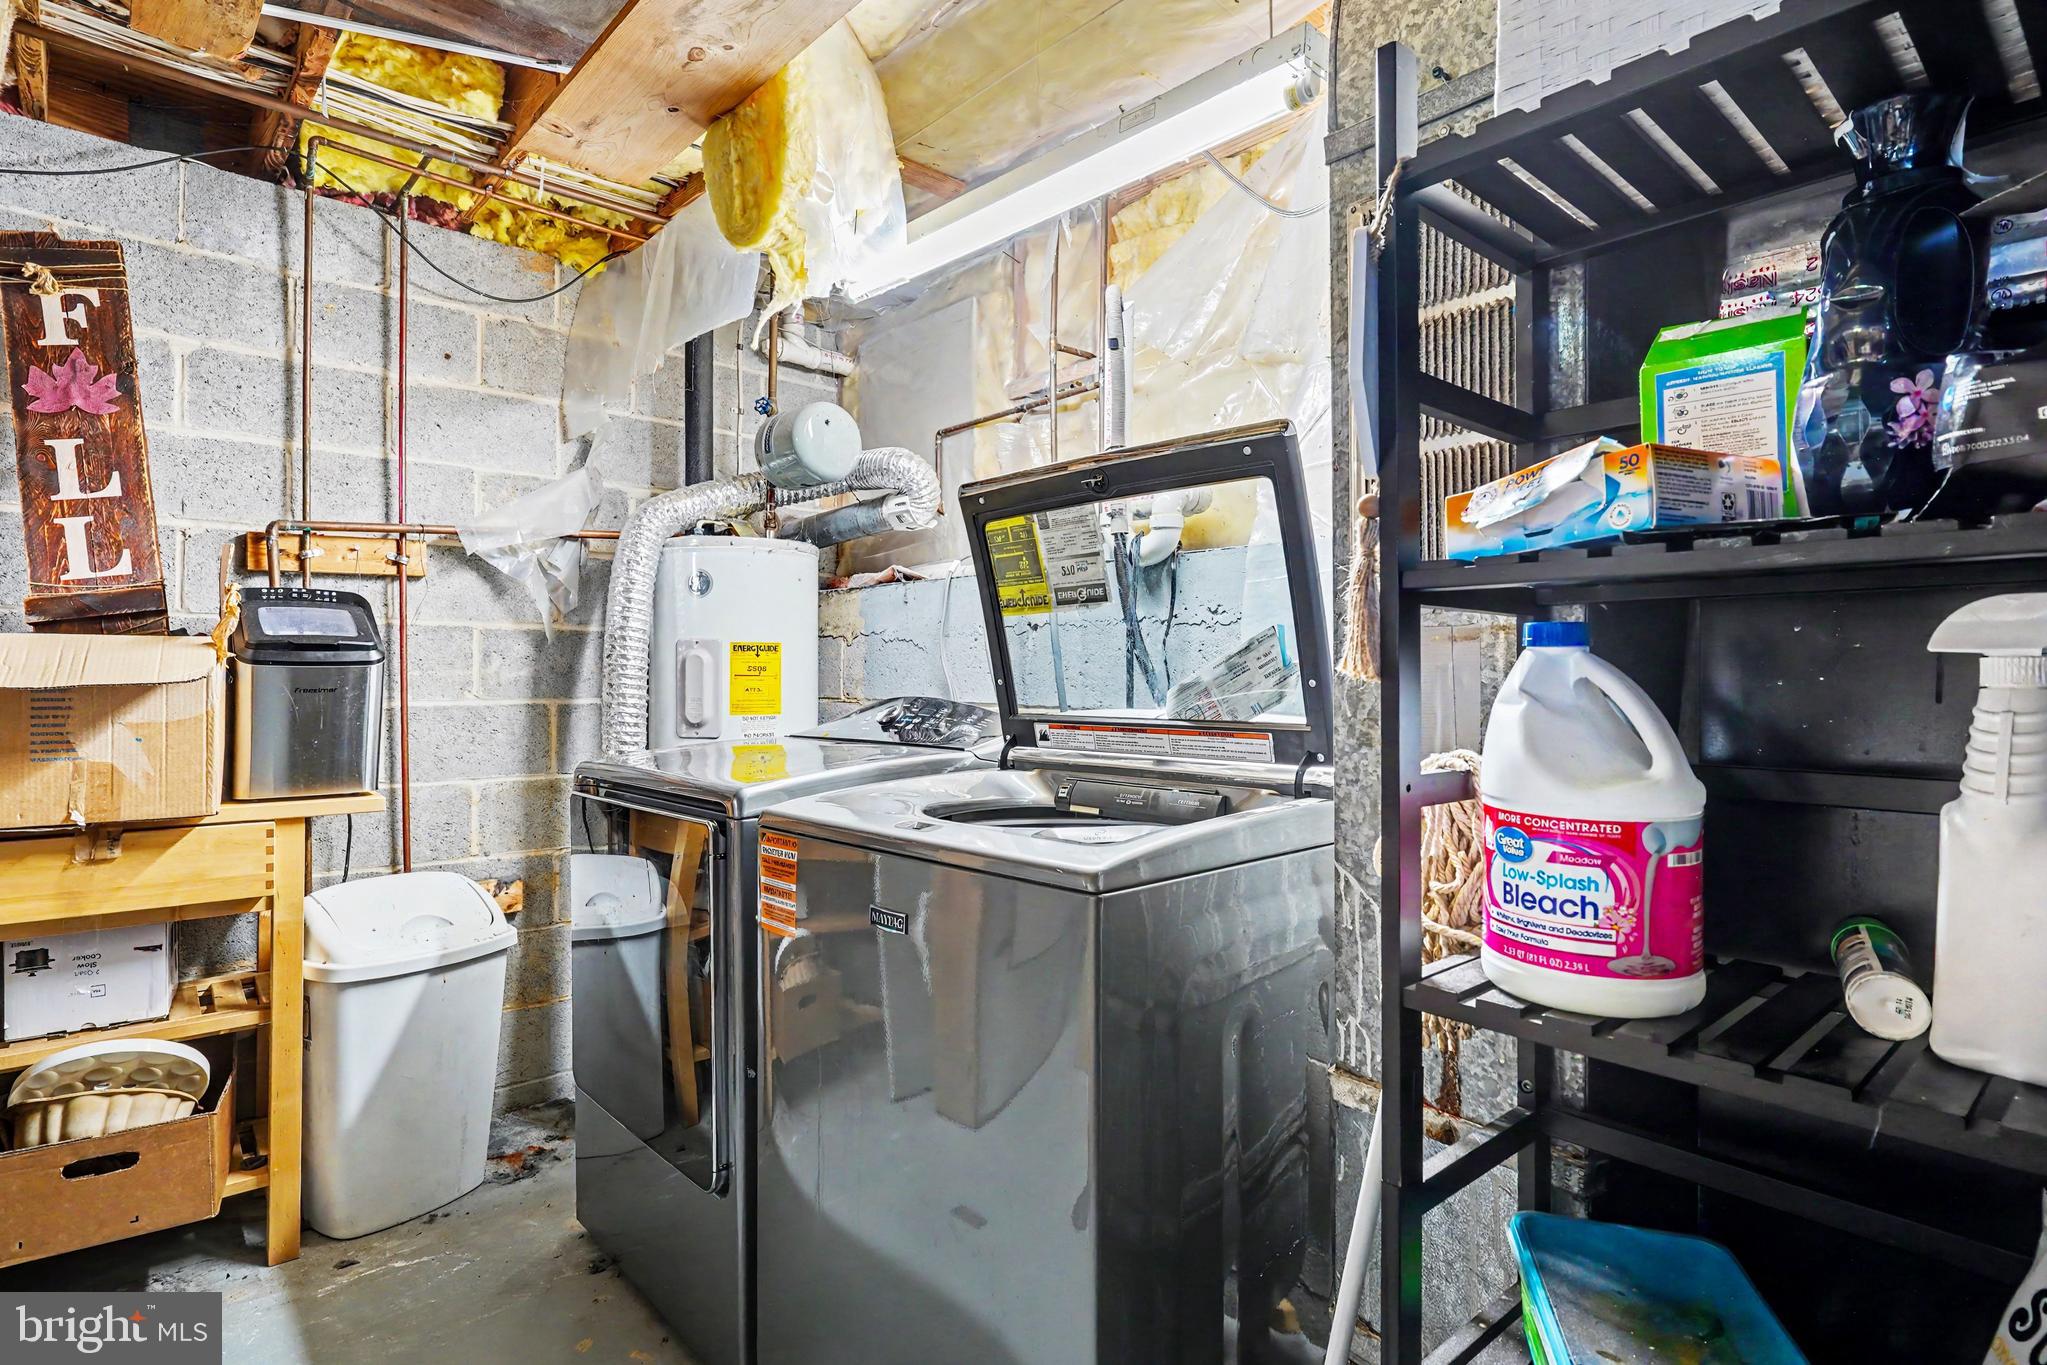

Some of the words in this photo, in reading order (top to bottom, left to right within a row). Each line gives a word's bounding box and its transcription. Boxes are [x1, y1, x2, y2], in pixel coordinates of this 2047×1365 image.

[1619, 453, 1640, 471] 50
[1498, 811, 1521, 825] MORE
[1523, 816, 1622, 834] CONCENTRATED
[1496, 832, 1525, 850] Great
[1502, 844, 1525, 857] Value
[1559, 853, 1602, 866] Meadow
[1502, 862, 1600, 893] Low-Splash
[1502, 880, 1600, 921] Bleach
[1520, 933, 1549, 946] Formula
[1548, 925, 1564, 934] and
[1565, 927, 1613, 940] Deodorizes
[72, 953, 102, 962] Cooker
[1516, 948, 1525, 959] QT
[1538, 955, 1548, 965] FL
[1549, 957, 1563, 969] OZ)
[1564, 961, 1583, 972] 2.39
[1584, 963, 1590, 972] L
